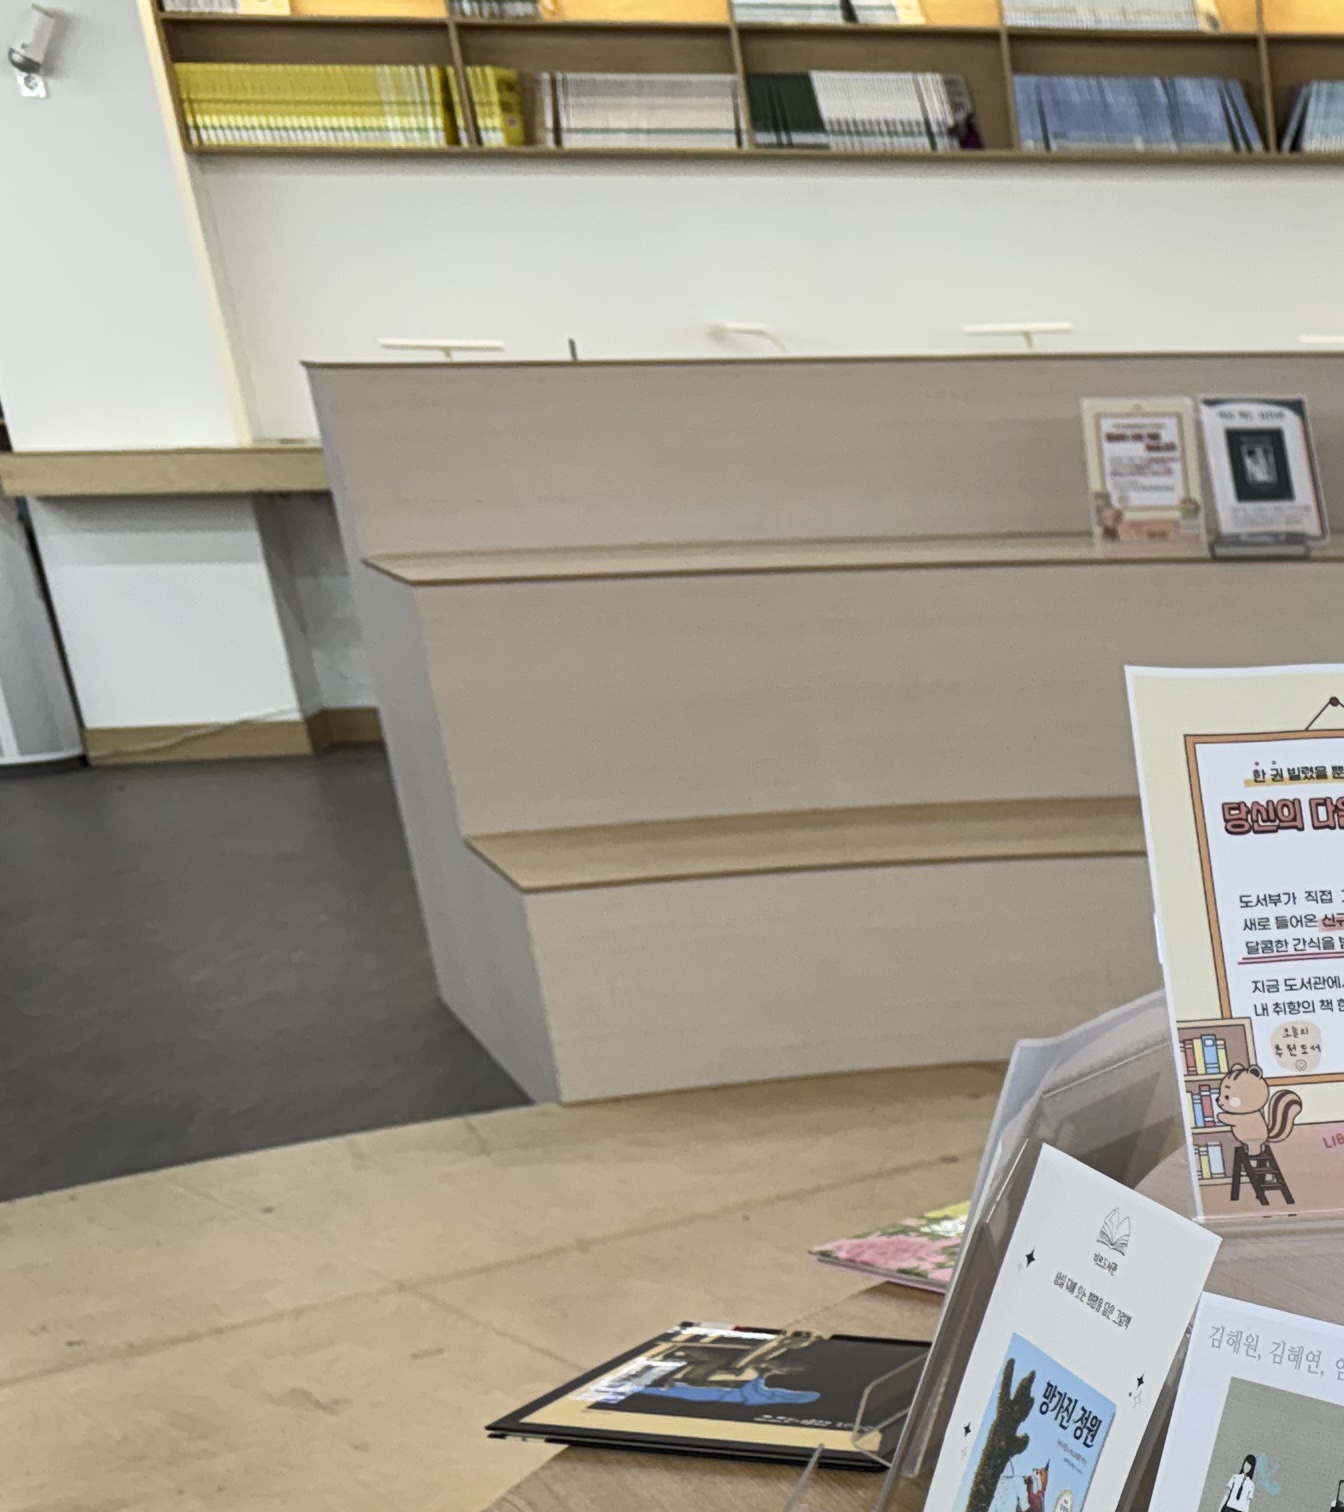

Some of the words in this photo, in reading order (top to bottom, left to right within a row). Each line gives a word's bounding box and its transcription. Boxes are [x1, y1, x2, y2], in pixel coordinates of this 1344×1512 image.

[1252, 768, 1266, 783] 한
[1269, 767, 1284, 782] 권
[1286, 765, 1328, 781] 빌렸을
[1221, 797, 1304, 835] 당신의
[1239, 891, 1296, 908] 도서부가
[1304, 889, 1333, 904] 직접
[1243, 916, 1271, 930] 새로
[1274, 913, 1318, 929] 들어온
[1245, 938, 1288, 955] 달콤한
[1292, 935, 1334, 951] 간식을
[1251, 978, 1279, 993] 지금
[1253, 1002, 1269, 1016] 내
[1272, 999, 1315, 1015] 취향의
[1318, 998, 1333, 1012] 책
[1208, 1325, 1261, 1360] 김해원,
[1269, 1340, 1324, 1376] 김혜연,
[1039, 1380, 1074, 1426] 망가진
[1072, 1404, 1104, 1450] 정원
